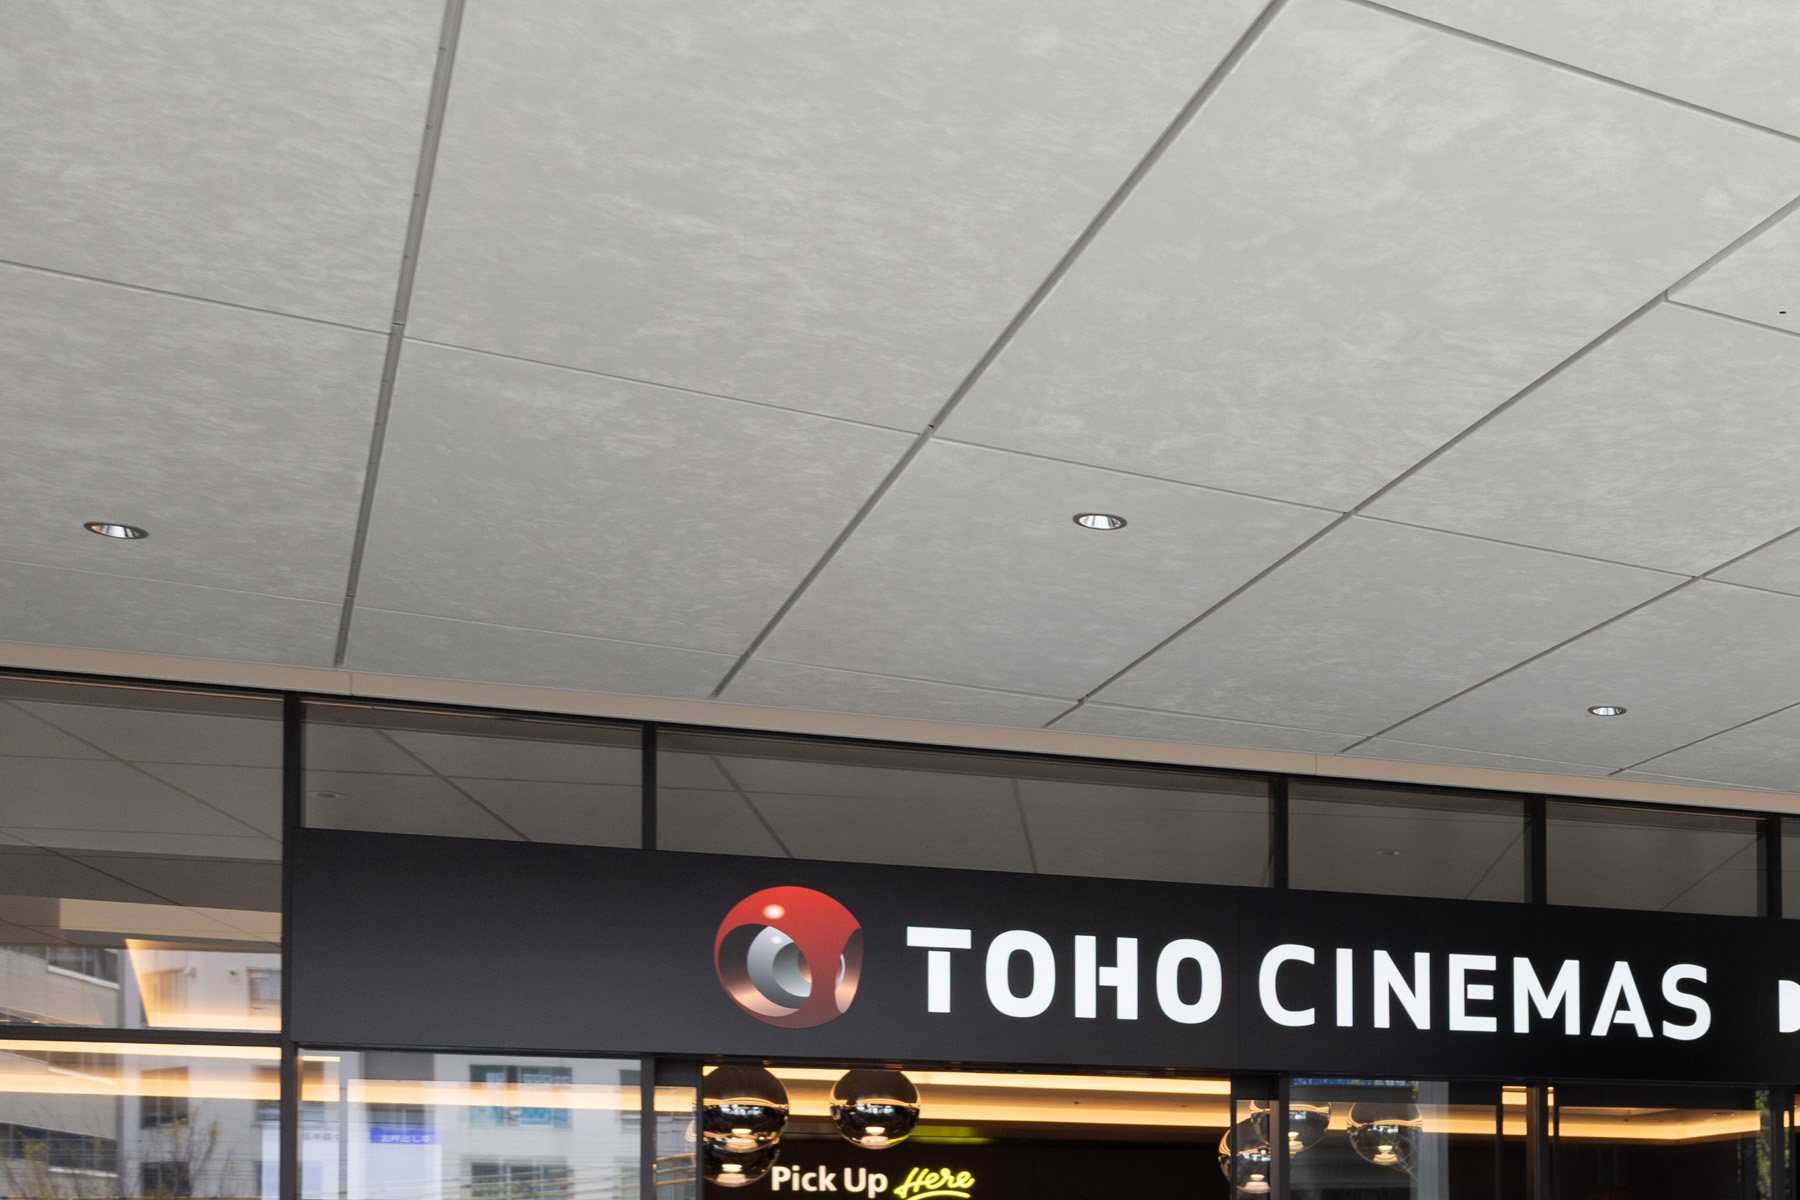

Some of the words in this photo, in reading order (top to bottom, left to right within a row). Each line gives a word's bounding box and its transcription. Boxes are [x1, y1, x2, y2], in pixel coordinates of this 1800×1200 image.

[906, 926, 1223, 1024] TOHO
[1258, 943, 1712, 1041] CINEMAS
[771, 1165, 838, 1192] Pick
[843, 1167, 888, 1199] Up
[893, 1166, 976, 1199] Here
